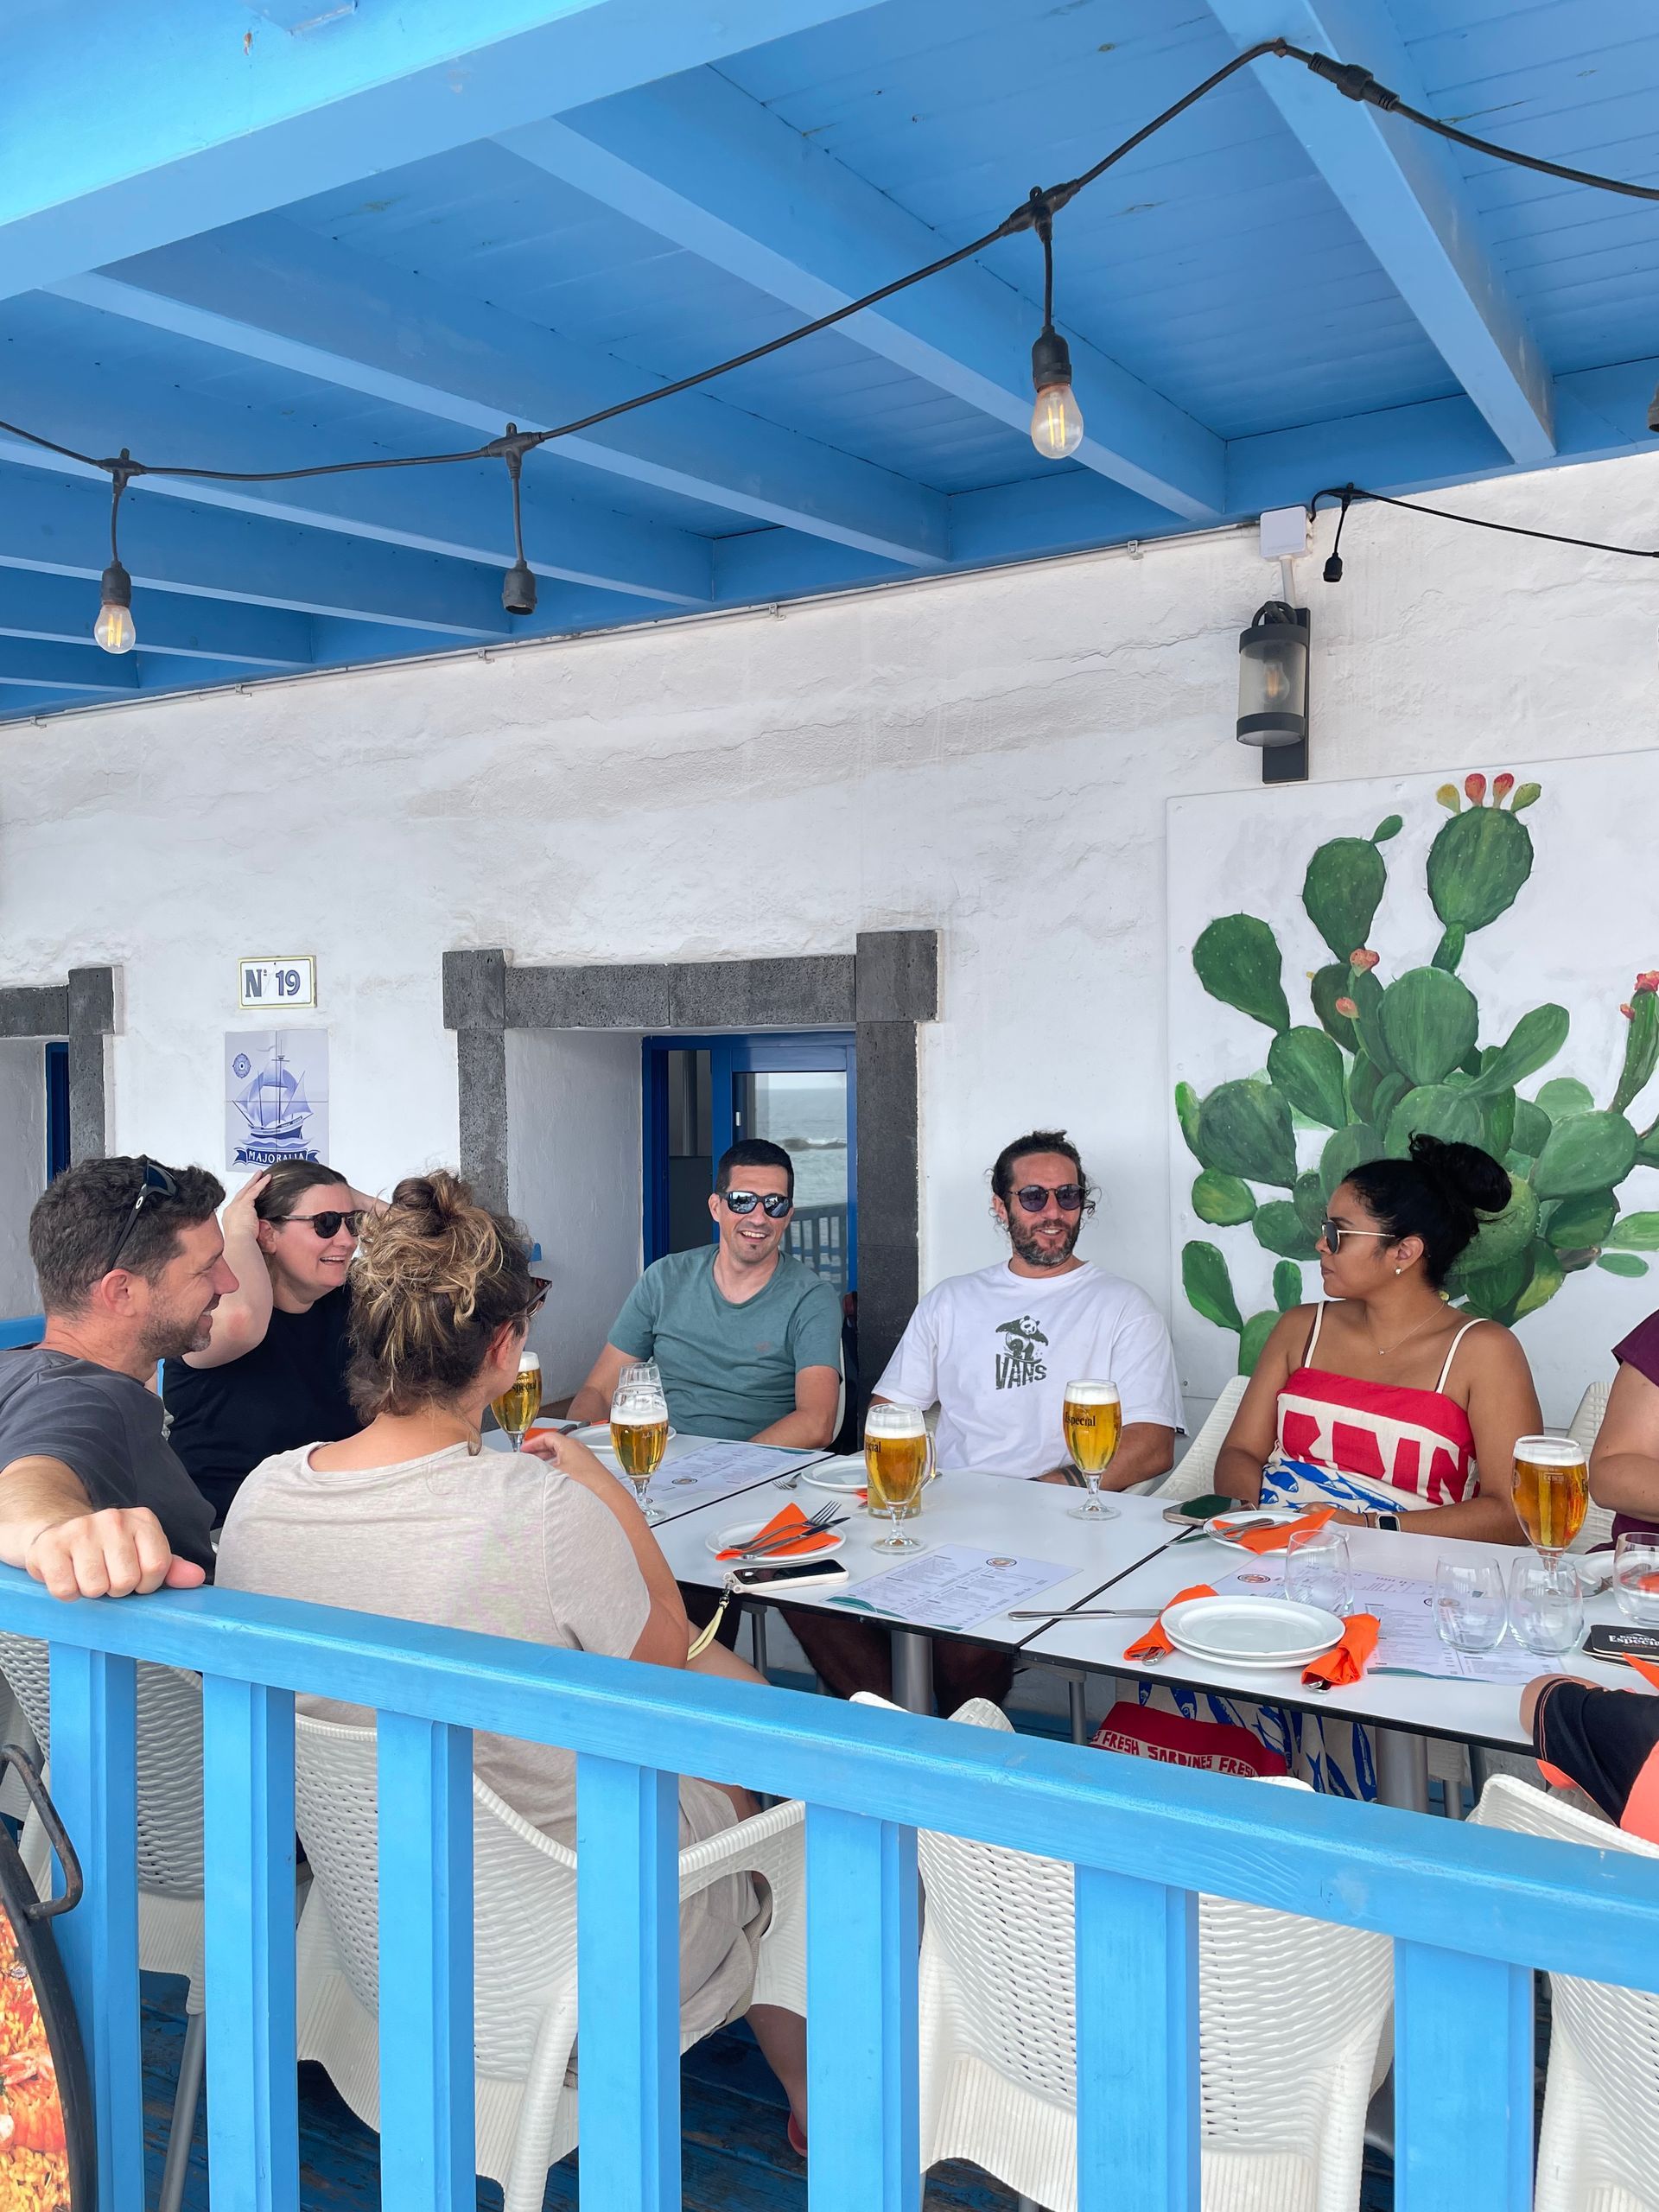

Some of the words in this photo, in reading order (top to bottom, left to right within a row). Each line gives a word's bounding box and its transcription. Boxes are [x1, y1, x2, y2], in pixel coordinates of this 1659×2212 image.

[276, 969, 301, 996] 19
[995, 1353, 1047, 1389] VANS
[1103, 1731, 1141, 1756] FRESH
[1147, 1745, 1213, 1770] SARDINES
